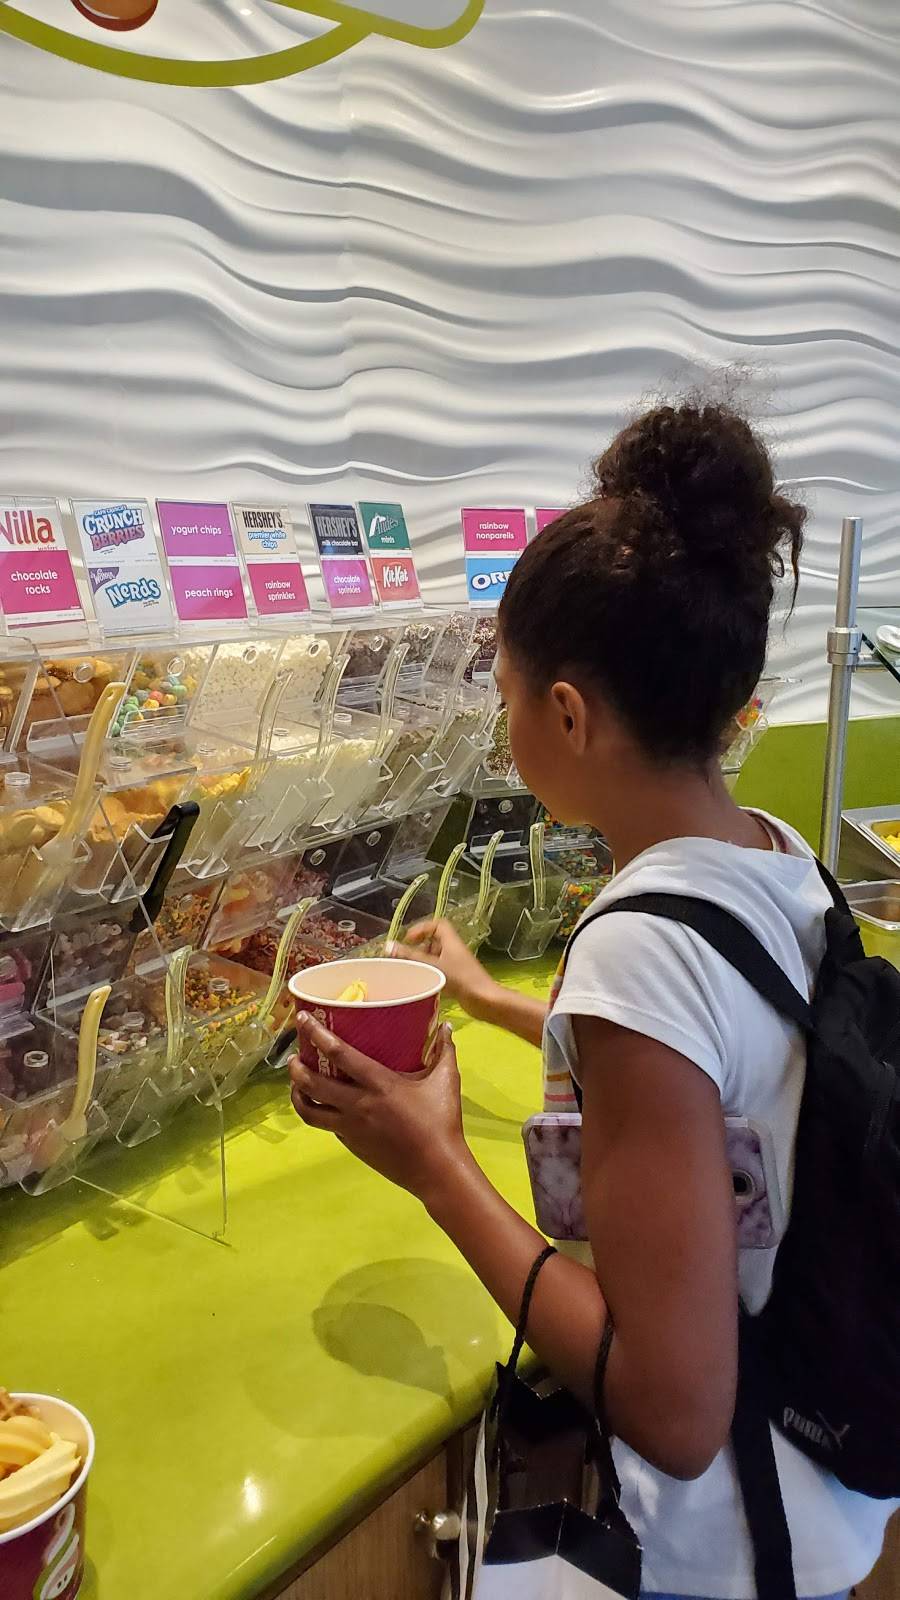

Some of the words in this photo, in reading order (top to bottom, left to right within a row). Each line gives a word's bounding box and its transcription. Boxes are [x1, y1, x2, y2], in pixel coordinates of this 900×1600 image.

[83, 509, 145, 535] CRUNCH
[242, 511, 283, 529] HERSHEY'S
[171, 525, 198, 535] yogurt
[200, 525, 222, 536] chips
[315, 516, 358, 538] HERSHEY'S
[479, 522, 509, 530] rainbow
[90, 525, 145, 551] BERRIES
[476, 532, 514, 541] nonpareils
[10, 570, 58, 581] chocolate
[333, 575, 360, 583] chocolate
[25, 584, 51, 595] rocks
[265, 580, 291, 589] rainbow
[185, 588, 212, 599] peach
[214, 588, 233, 598] rings
[338, 586, 361, 595] sprinkles
[268, 592, 295, 602] sprinkles
